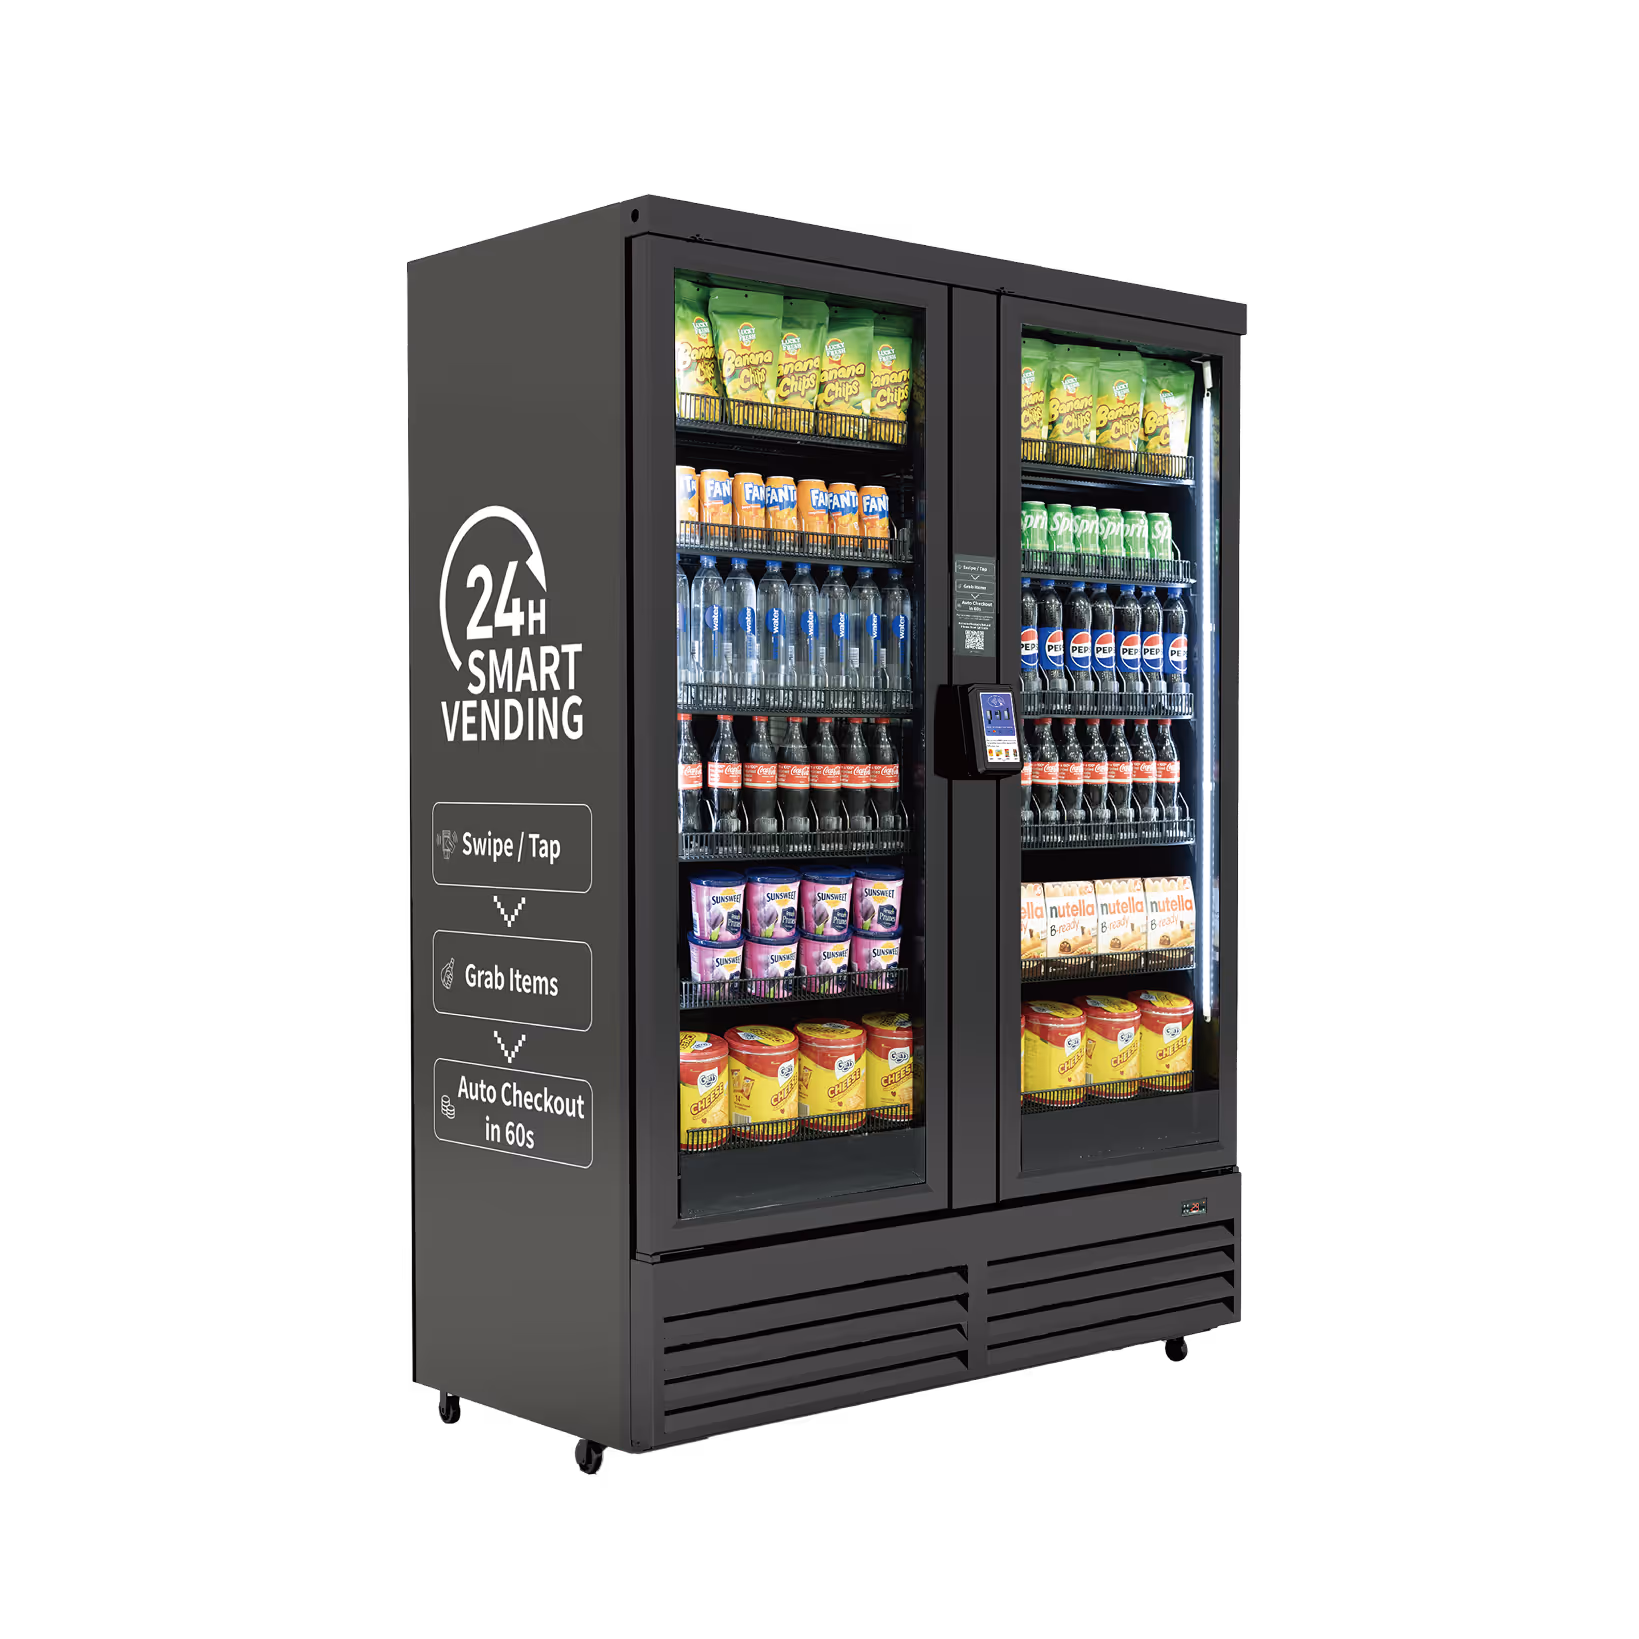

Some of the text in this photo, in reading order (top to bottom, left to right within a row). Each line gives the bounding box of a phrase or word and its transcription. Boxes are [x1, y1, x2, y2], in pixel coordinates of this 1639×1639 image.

[722, 349, 774, 379] Banana
[739, 366, 767, 391] Chips
[778, 372, 817, 399] Chips
[822, 380, 860, 405] Chips
[1063, 411, 1092, 435] Chips
[1111, 416, 1140, 441] Chips
[466, 560, 547, 640] 24H
[467, 643, 583, 695] SMART
[441, 695, 584, 742] VENDING
[462, 830, 561, 864] Swipe / Tap
[711, 893, 742, 905] SUNSWEET
[766, 891, 796, 902] SUNSWEET
[817, 892, 847, 902] SUNSWEET
[864, 888, 895, 899] SUNSWEET
[1100, 896, 1144, 915] nutella
[1150, 894, 1193, 913] nutella
[1050, 899, 1095, 918] nutella
[465, 963, 559, 996] Grab Items
[828, 1067, 861, 1098] CHEESE
[458, 1075, 585, 1119] Auto Checkout
[485, 1115, 535, 1149] in 60s
